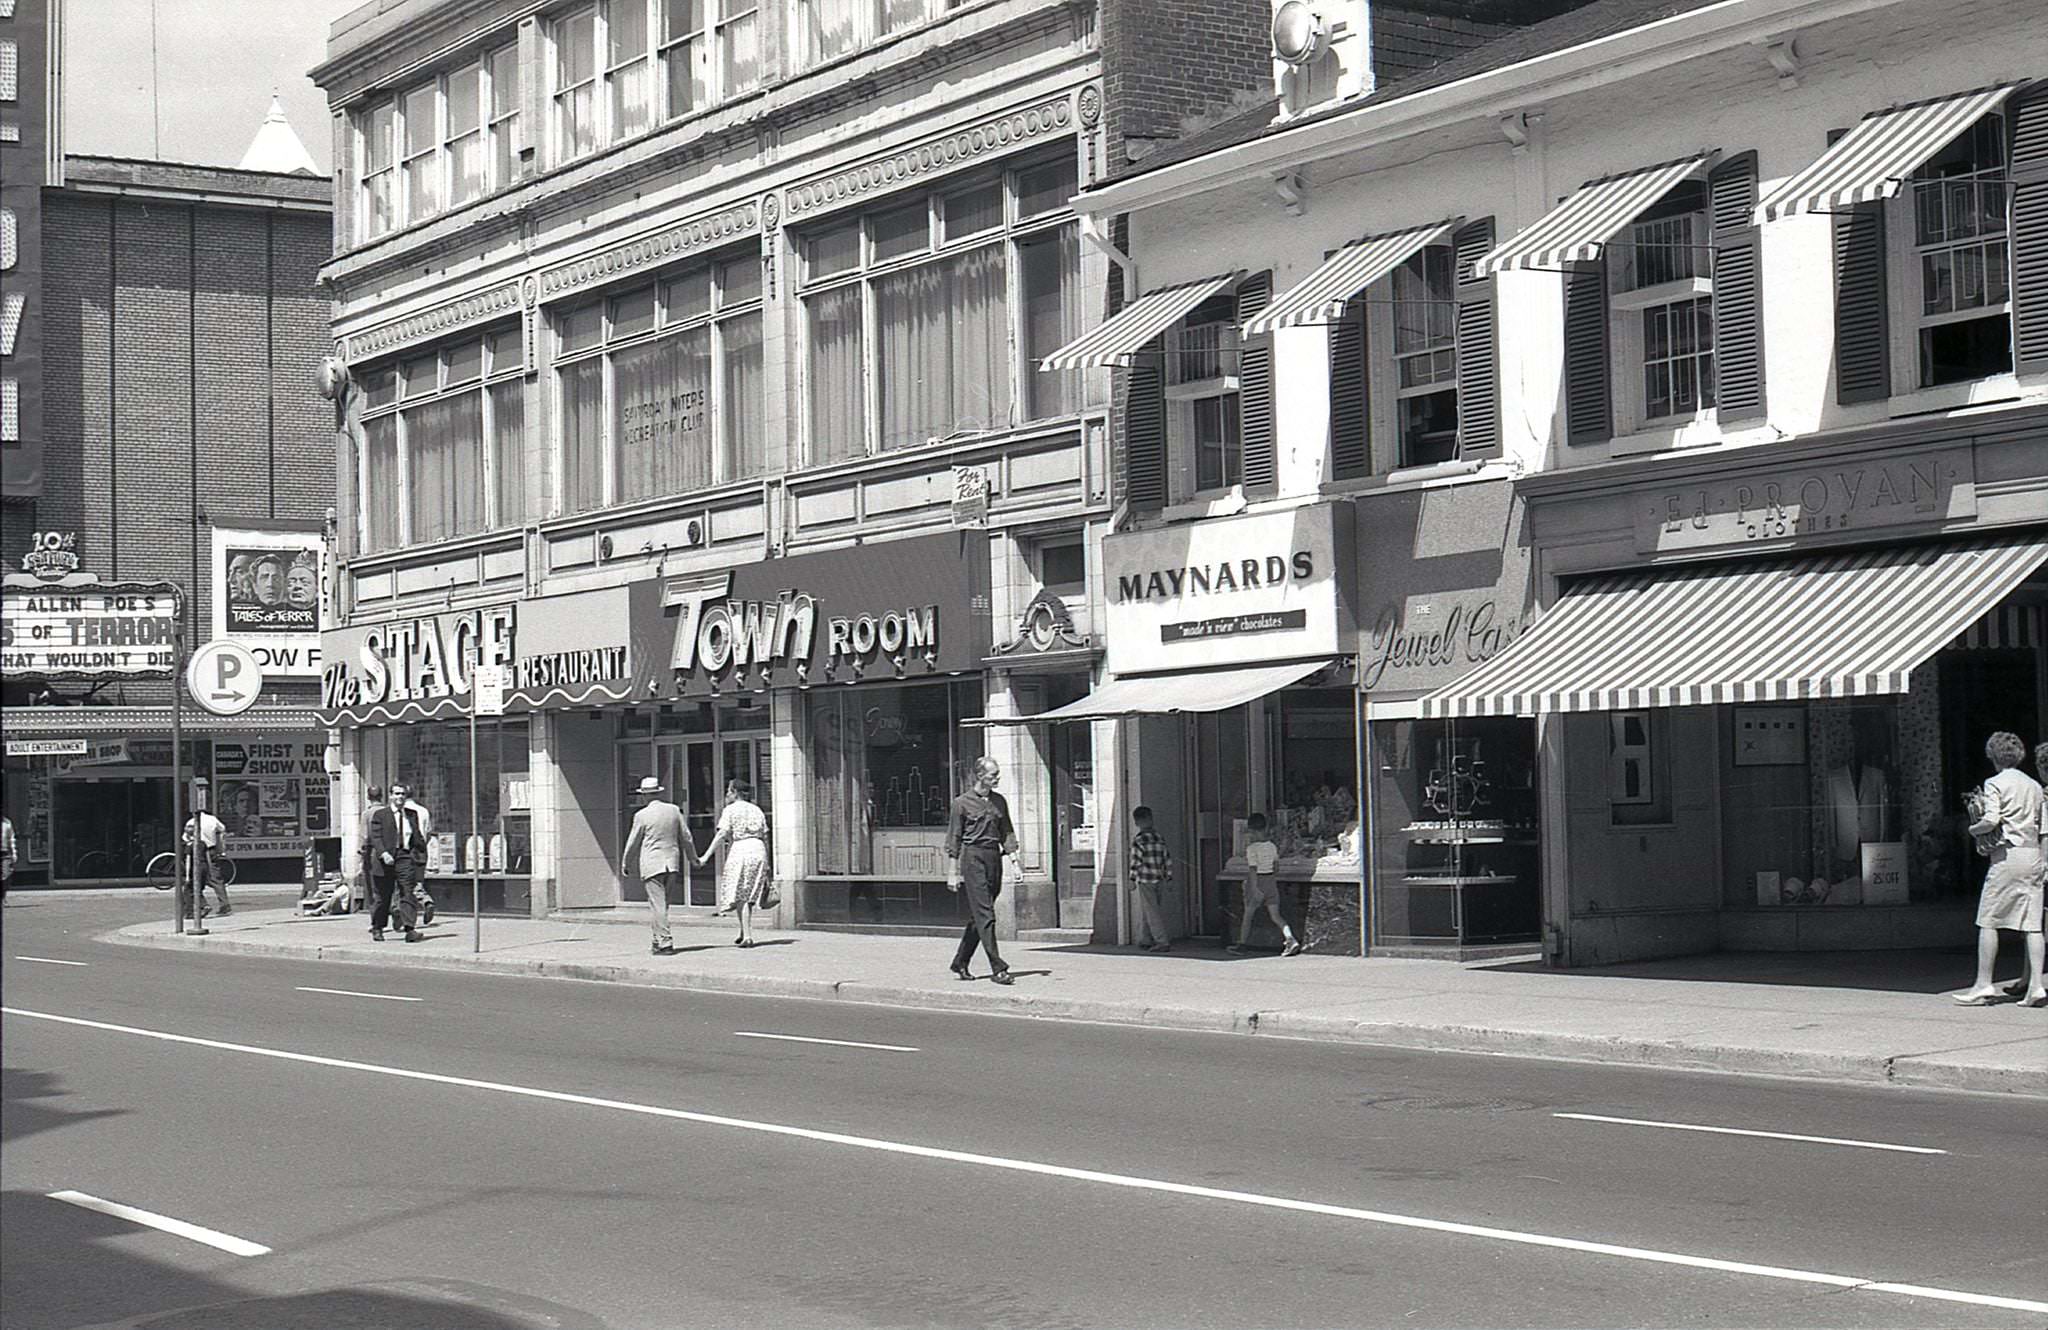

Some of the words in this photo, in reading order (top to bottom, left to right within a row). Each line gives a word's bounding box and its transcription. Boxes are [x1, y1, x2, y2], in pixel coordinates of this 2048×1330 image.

[957, 467, 980, 483] For
[957, 483, 986, 500] Rent
[1736, 460, 1940, 524] PROVAN
[1746, 513, 1849, 538] CLOTHES
[1118, 551, 1314, 605] MAYNARDS
[26, 597, 82, 612] ALLEN
[1415, 604, 1432, 615] THE
[232, 610, 264, 622] TALES
[1241, 615, 1282, 631] chocolates
[32, 625, 53, 640] OF
[66, 617, 172, 645] TERROR
[829, 605, 939, 657] ROOM
[1364, 604, 1462, 689] Jewel
[1464, 601, 1530, 662] Cas
[148, 652, 174, 667] DIE
[324, 660, 360, 708] The
[360, 604, 517, 704] STAGE
[217, 653, 241, 689] P
[521, 646, 630, 688] RESTAURANT
[248, 744, 293, 758] FIRST
[249, 760, 294, 774] SHOW
